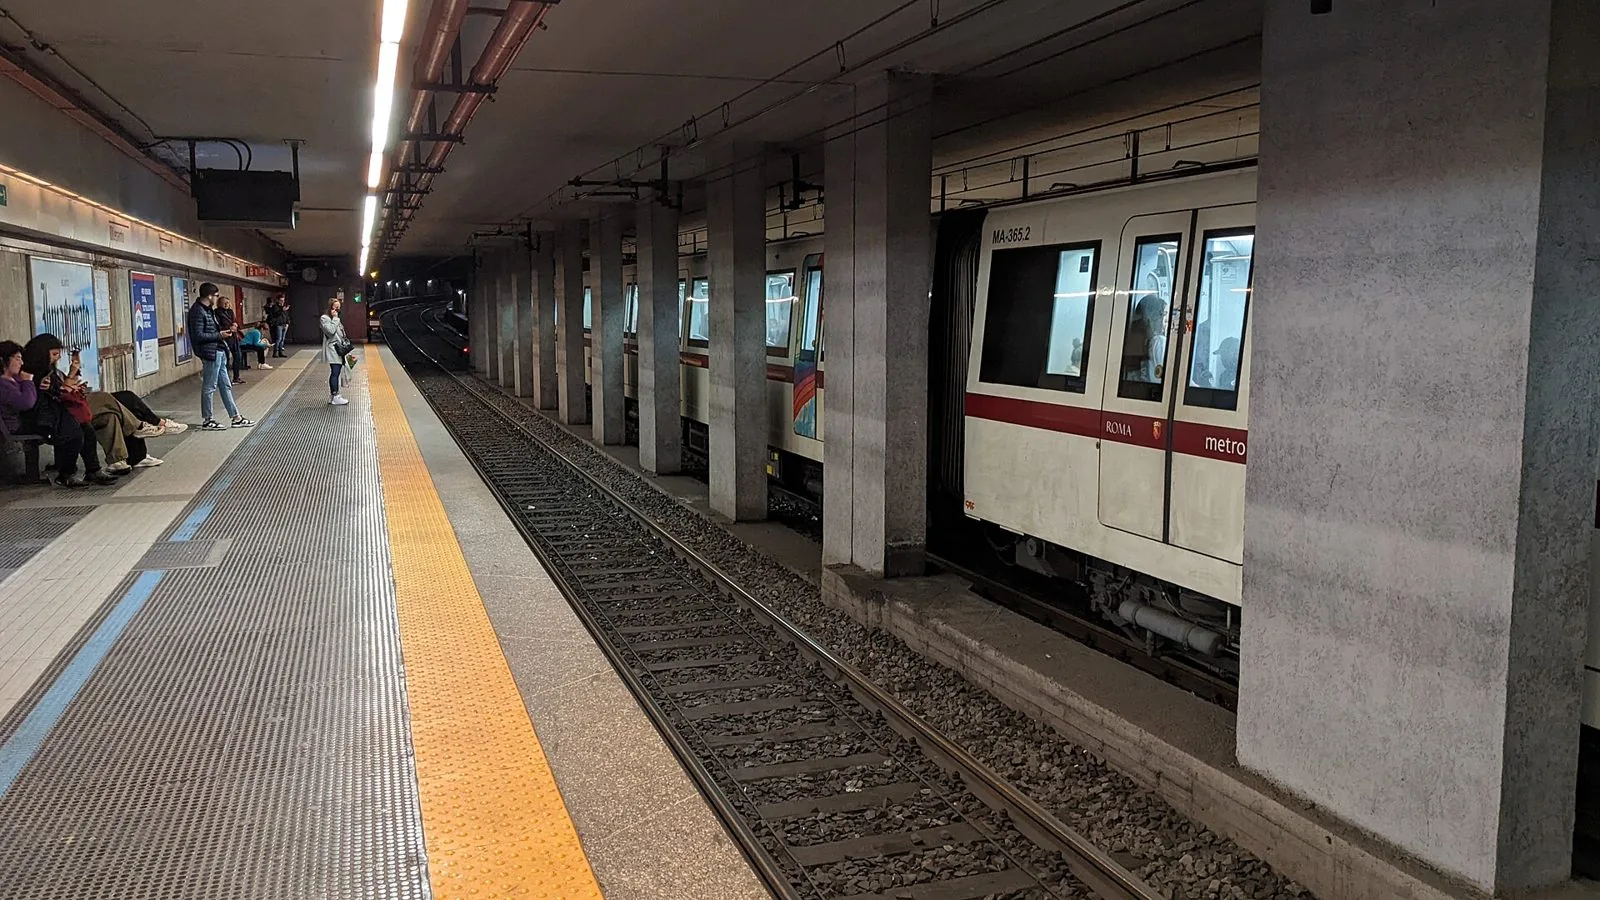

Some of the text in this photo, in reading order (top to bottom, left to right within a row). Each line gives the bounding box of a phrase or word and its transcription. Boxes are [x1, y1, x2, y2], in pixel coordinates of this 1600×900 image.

[992, 226, 1031, 244] MA-365.2
[1105, 420, 1132, 437] ROMA
[1205, 436, 1246, 456] metro
